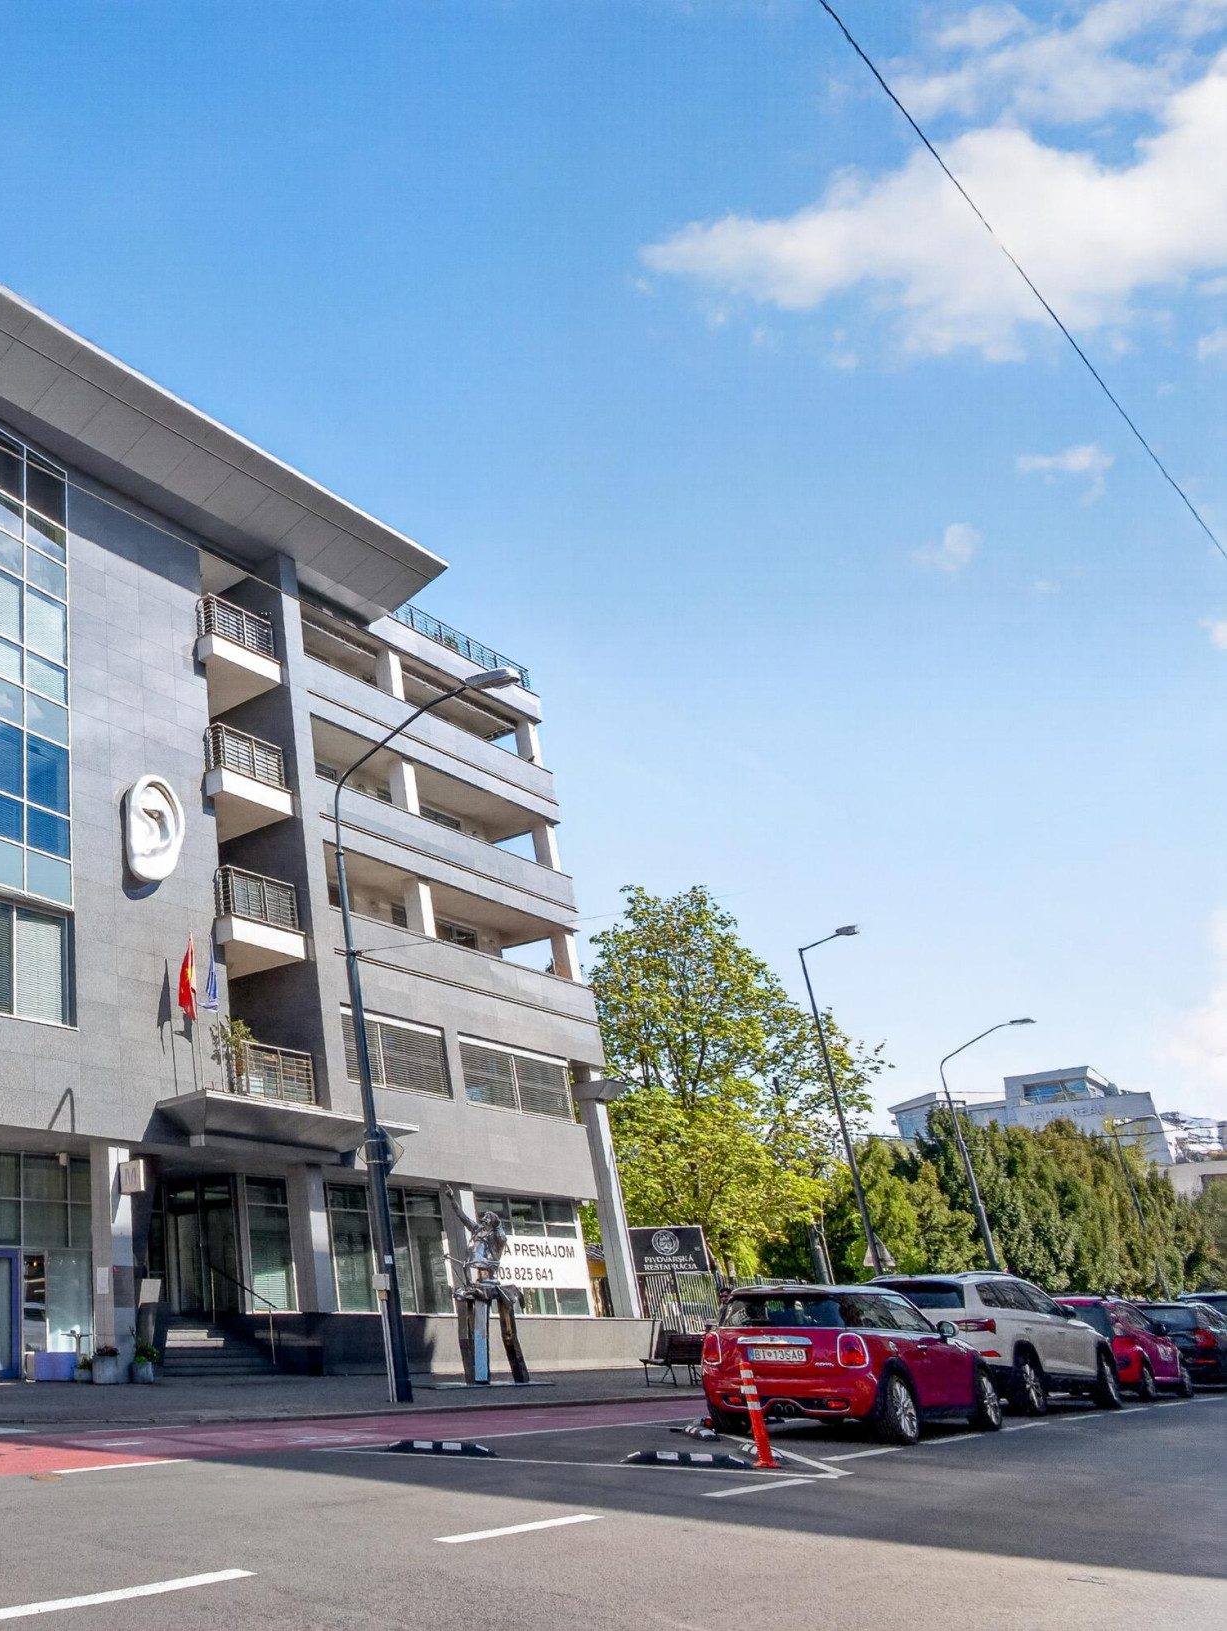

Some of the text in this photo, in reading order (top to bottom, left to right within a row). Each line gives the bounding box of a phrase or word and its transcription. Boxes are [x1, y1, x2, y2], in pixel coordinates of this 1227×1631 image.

[125, 1167, 136, 1186] M
[504, 1242, 575, 1258] A PRENÁJOM
[644, 1253, 694, 1263] PIVOVARSKÁ
[515, 1267, 533, 1281] 825
[535, 1268, 554, 1281] 641
